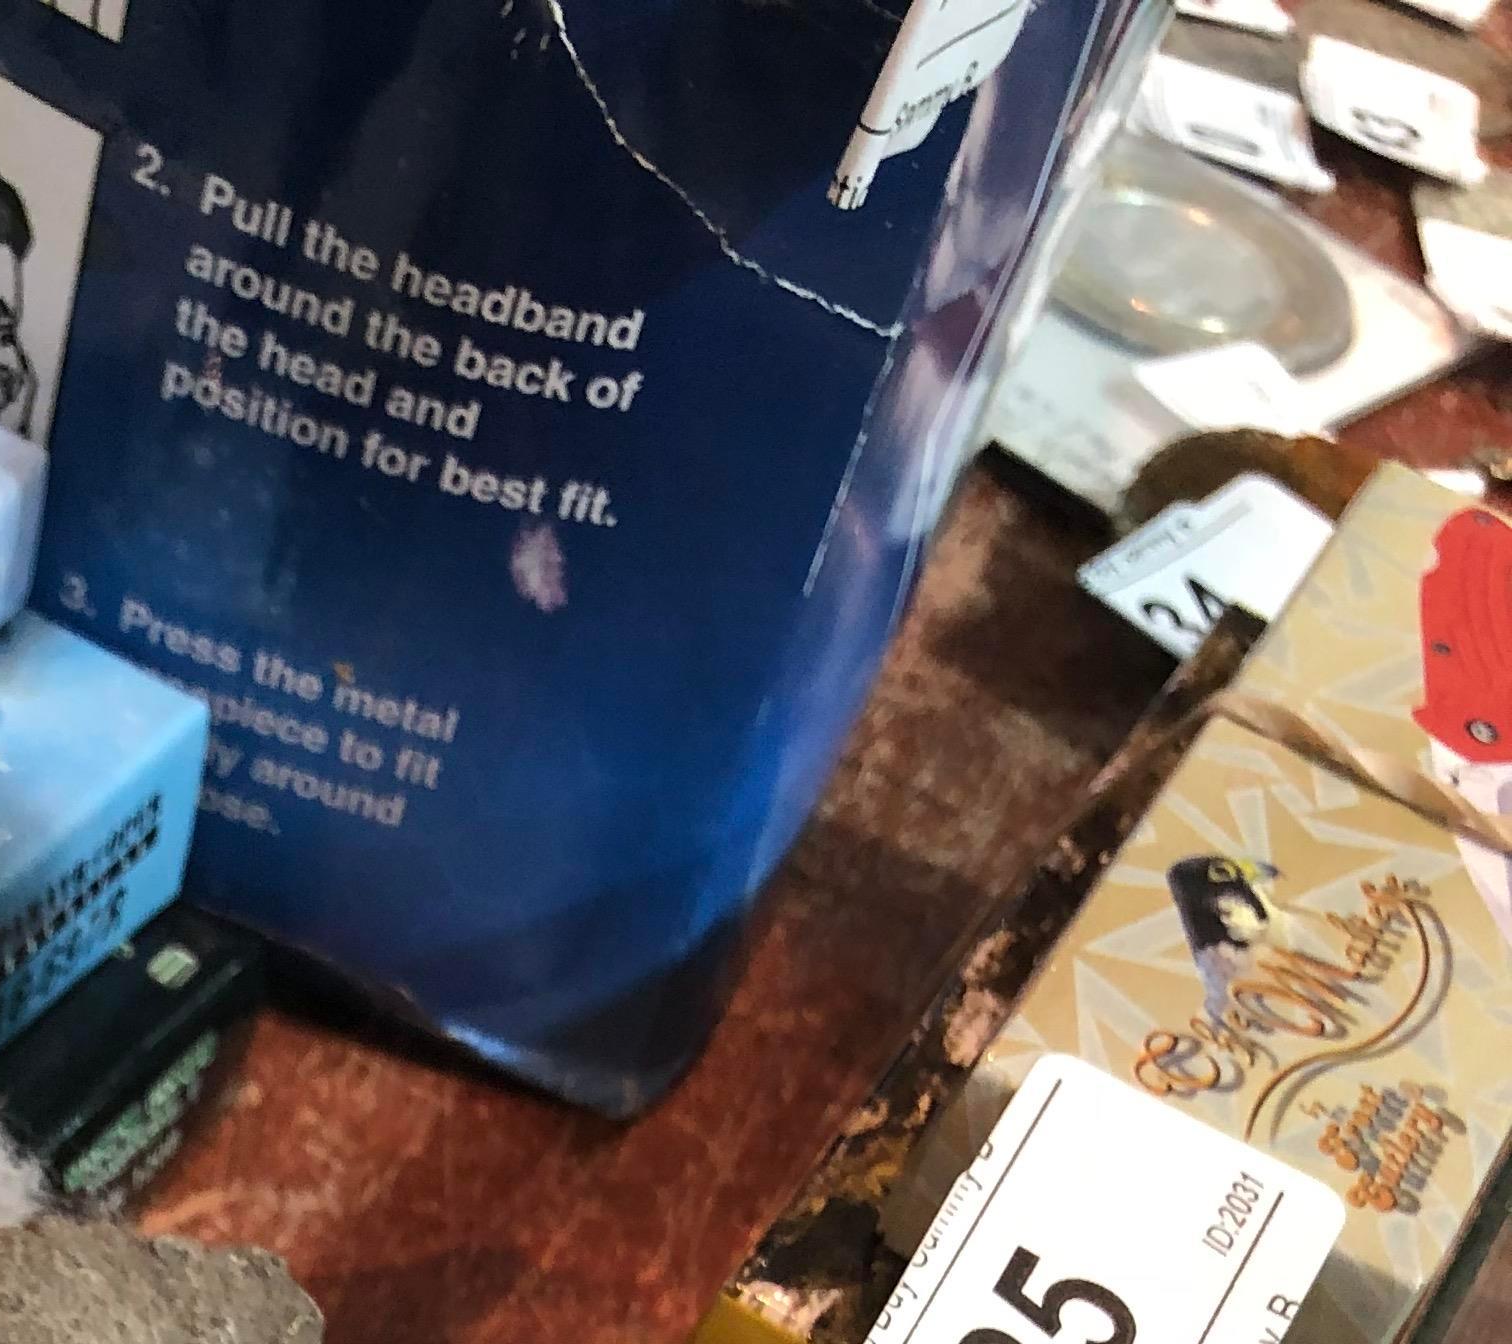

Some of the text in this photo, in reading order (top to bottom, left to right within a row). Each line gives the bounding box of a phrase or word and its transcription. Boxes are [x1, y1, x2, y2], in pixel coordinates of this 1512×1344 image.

[131, 143, 646, 353] 2. Pull the headband
[173, 295, 485, 442] the head and
[185, 243, 646, 413] around the back of
[160, 359, 619, 529] position for best fit.
[59, 571, 98, 620] 3.
[117, 595, 243, 676] Press
[253, 648, 325, 703] the
[332, 683, 461, 744] metal
[249, 756, 408, 829] around
[339, 727, 385, 772] to
[394, 743, 443, 791] fit
[1201, 1169, 1265, 1258] ID:2031
